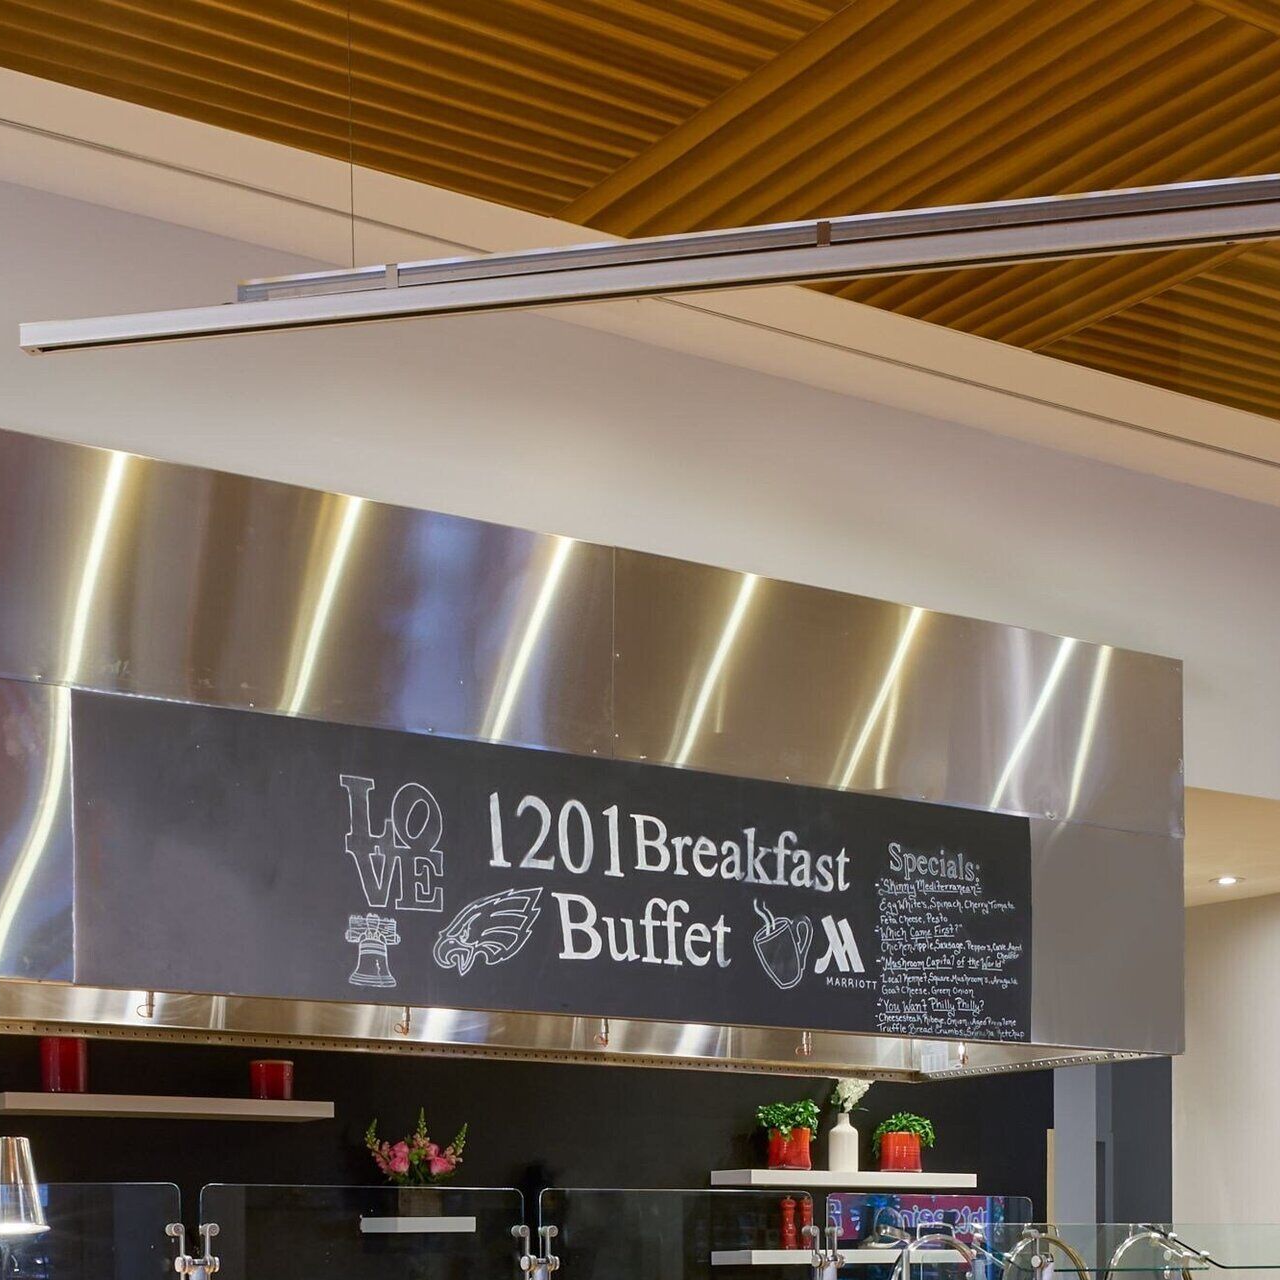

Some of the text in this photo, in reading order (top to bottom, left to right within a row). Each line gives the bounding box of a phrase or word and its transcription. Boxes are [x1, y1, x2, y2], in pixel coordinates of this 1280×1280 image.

[489, 791, 851, 893] 1201 Breakfast
[887, 842, 980, 883] Specials:
[880, 915, 898, 924] Feta
[926, 913, 948, 923] Pesto
[551, 891, 732, 969] Buffet
[910, 927, 933, 940] Came
[926, 954, 955, 970] Capital
[956, 956, 966, 968] of
[967, 956, 980, 969] the
[826, 976, 877, 991] MARRIOTT
[880, 973, 902, 983] Local
[881, 985, 900, 995] Goat
[931, 986, 951, 997] Green
[952, 986, 975, 998] Onion
[901, 999, 927, 1013] Want
[928, 997, 956, 1017] Philly
[876, 1022, 907, 1033] Truffle
[908, 1023, 933, 1034] Bread
